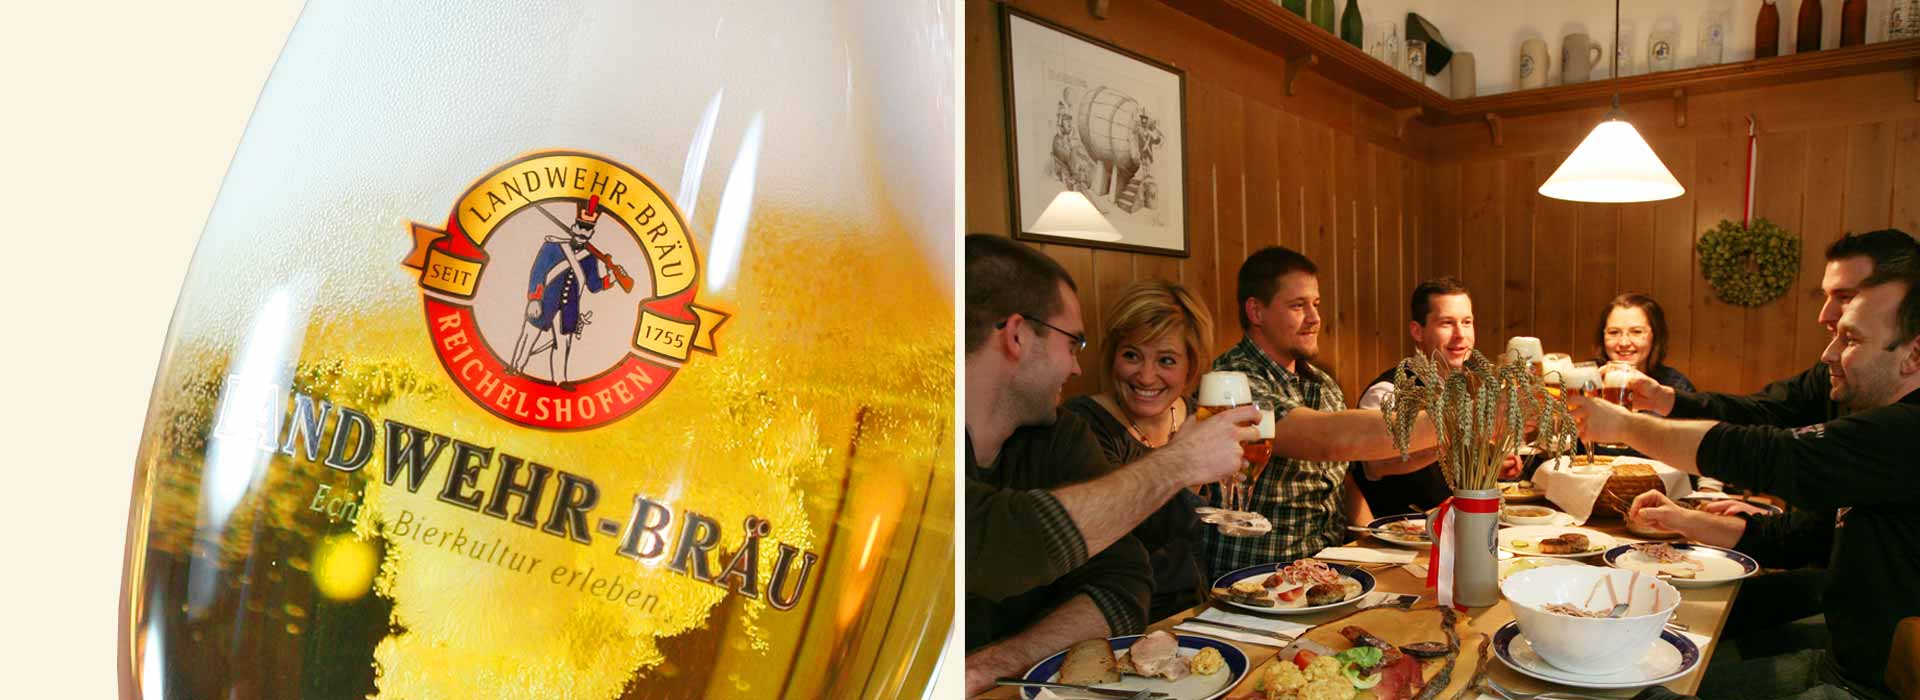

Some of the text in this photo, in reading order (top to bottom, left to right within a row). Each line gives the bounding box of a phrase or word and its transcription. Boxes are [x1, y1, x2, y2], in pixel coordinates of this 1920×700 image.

[431, 263, 472, 286] SEIT
[469, 166, 683, 279] LANDWEHR-BRÄU
[437, 311, 653, 423] REICHELSHOFEN
[645, 325, 685, 349] 1755
[309, 483, 660, 614] Ech Bierkultur erleben
